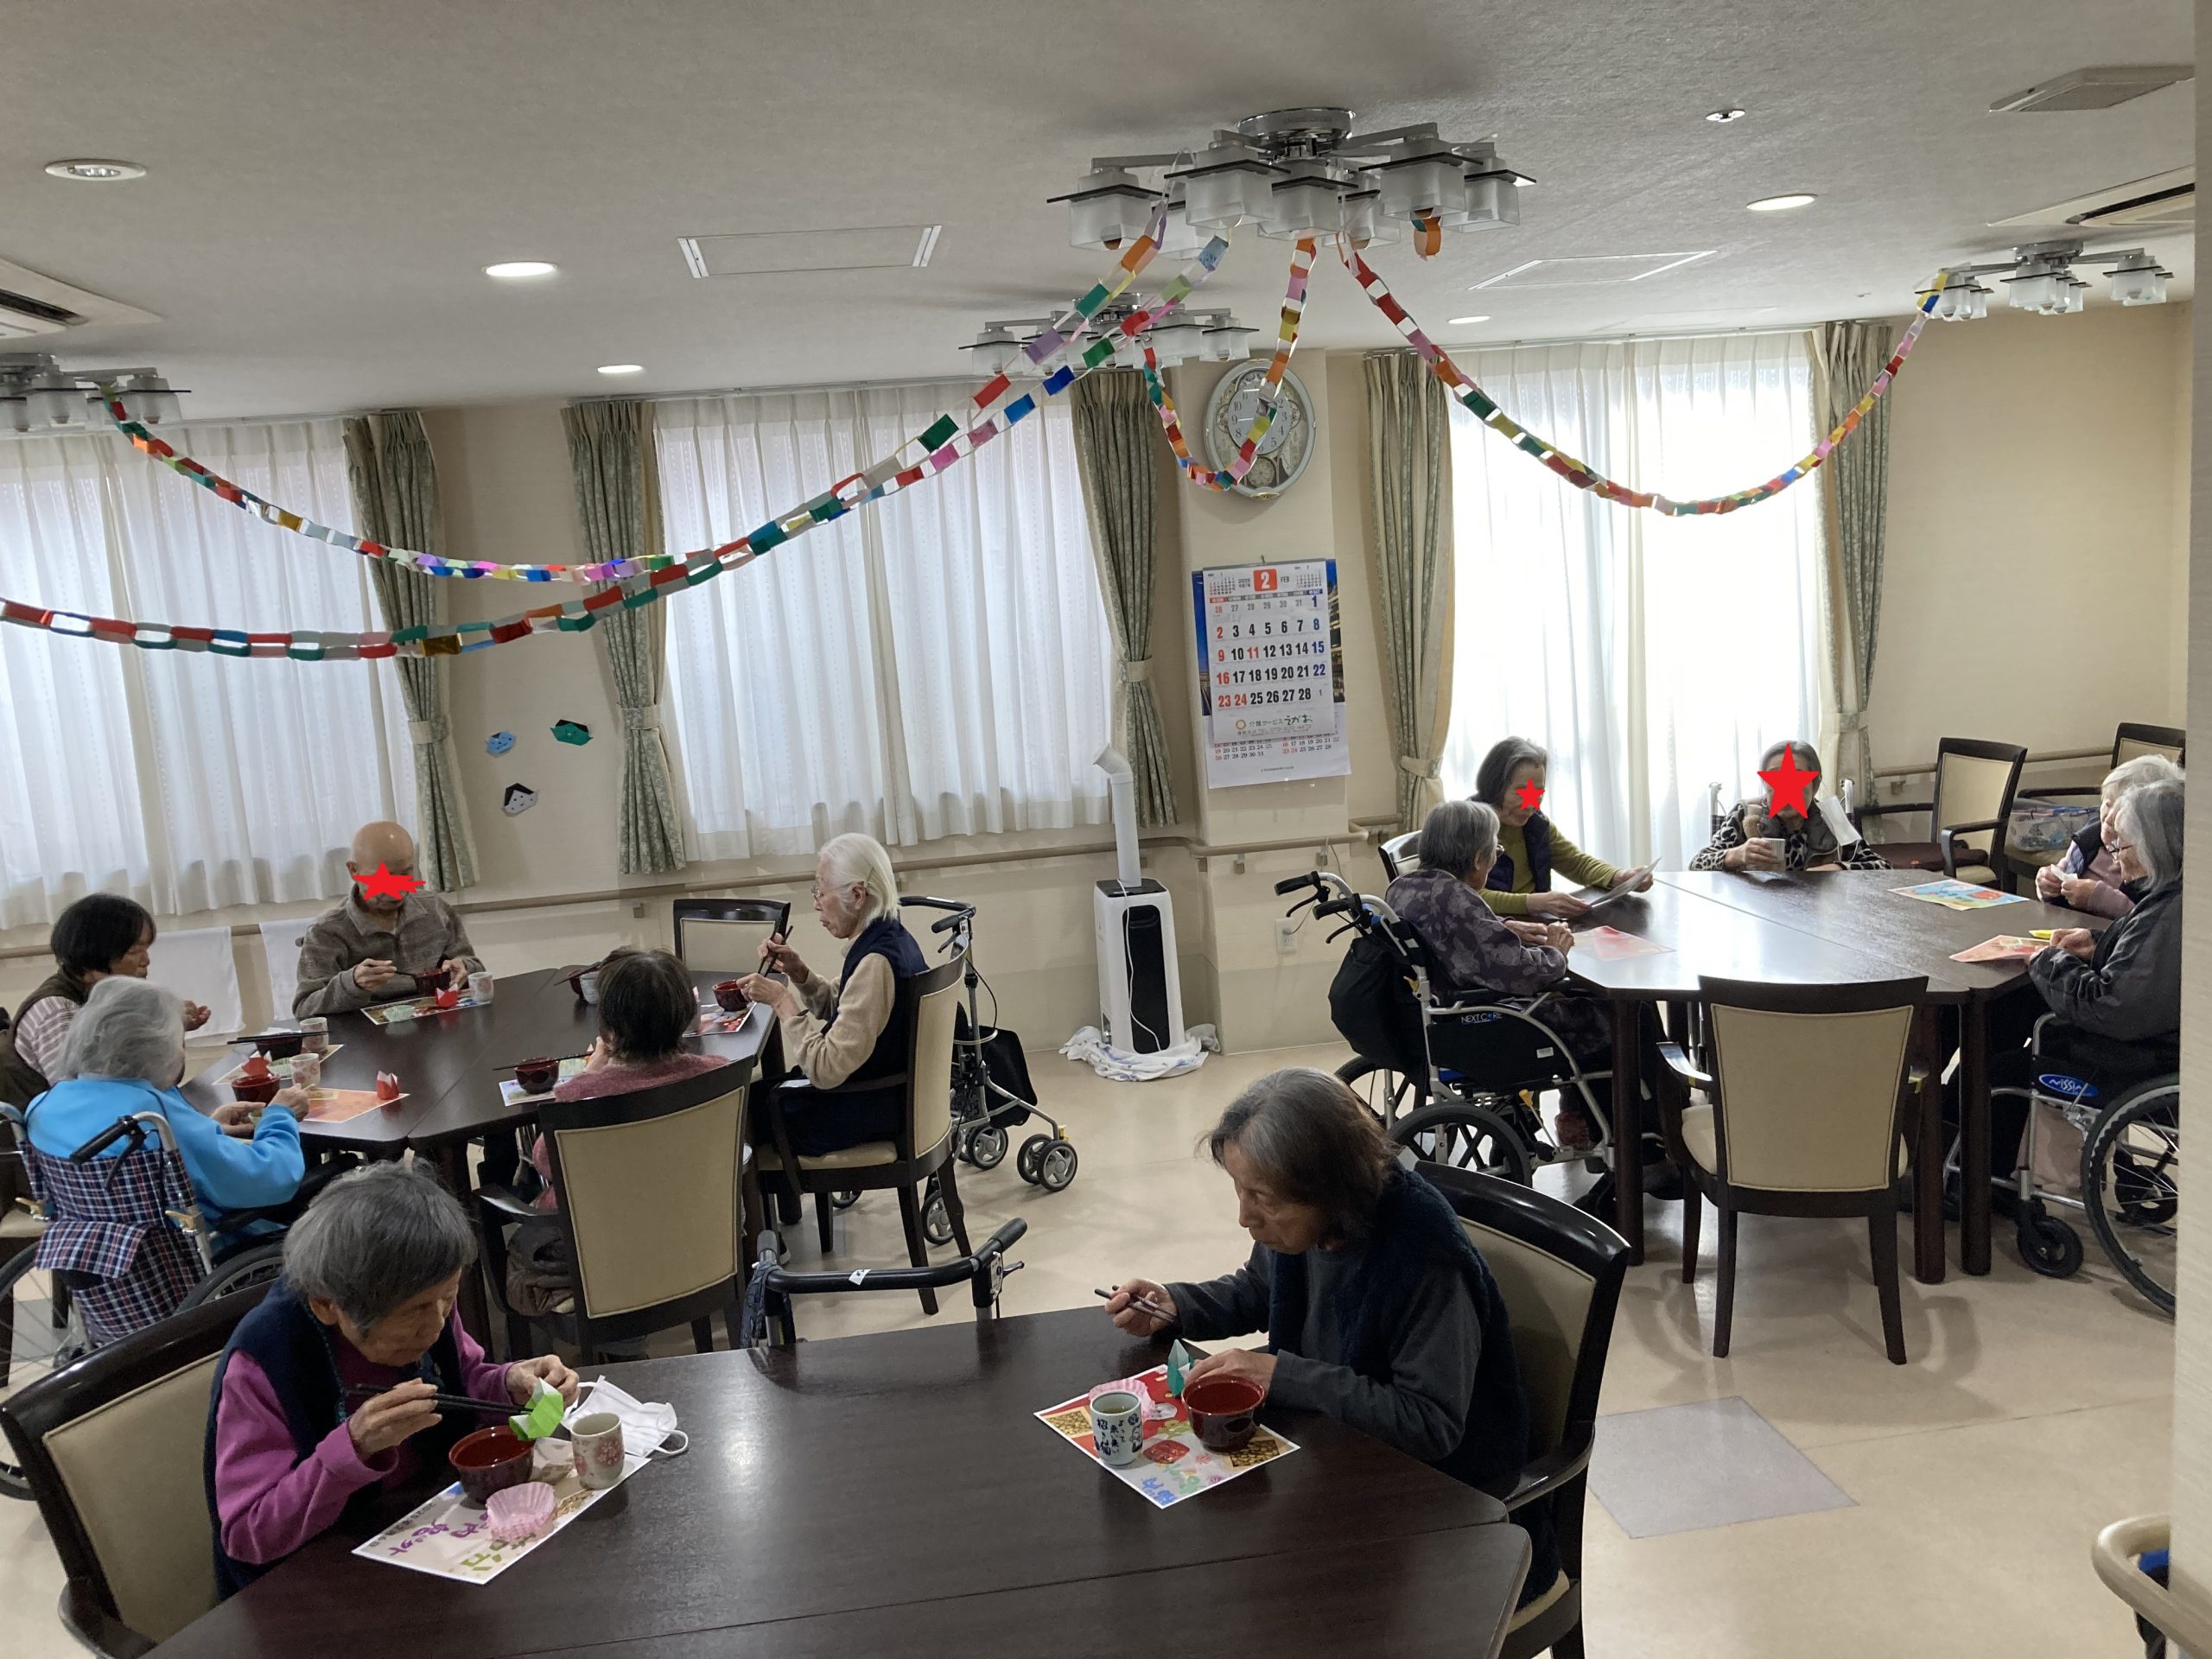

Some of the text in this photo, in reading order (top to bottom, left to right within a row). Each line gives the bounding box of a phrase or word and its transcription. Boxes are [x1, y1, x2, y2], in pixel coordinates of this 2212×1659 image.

[1234, 401, 1242, 411] 10
[1278, 399, 1283, 408] 2
[1231, 416, 1237, 424] 9
[1281, 412, 1287, 422] 3
[1236, 429, 1242, 437] 8
[1280, 426, 1283, 435] 4
[1272, 437, 1276, 447] 5
[1261, 571, 1269, 589] 2
[1312, 595, 1317, 607] 1
[1217, 619, 1319, 639] 2 3 4 5 6 7 8
[1218, 641, 1324, 661] 9 10 11 12 13 14 15
[1217, 664, 1325, 684] 16 17 18 19 20 21 22
[1218, 695, 1231, 708] 23
[1235, 694, 1247, 706] 24
[1250, 692, 1263, 704] 25
[1267, 690, 1279, 703] 26
[1282, 690, 1294, 702] 27
[1299, 688, 1311, 700] 28
